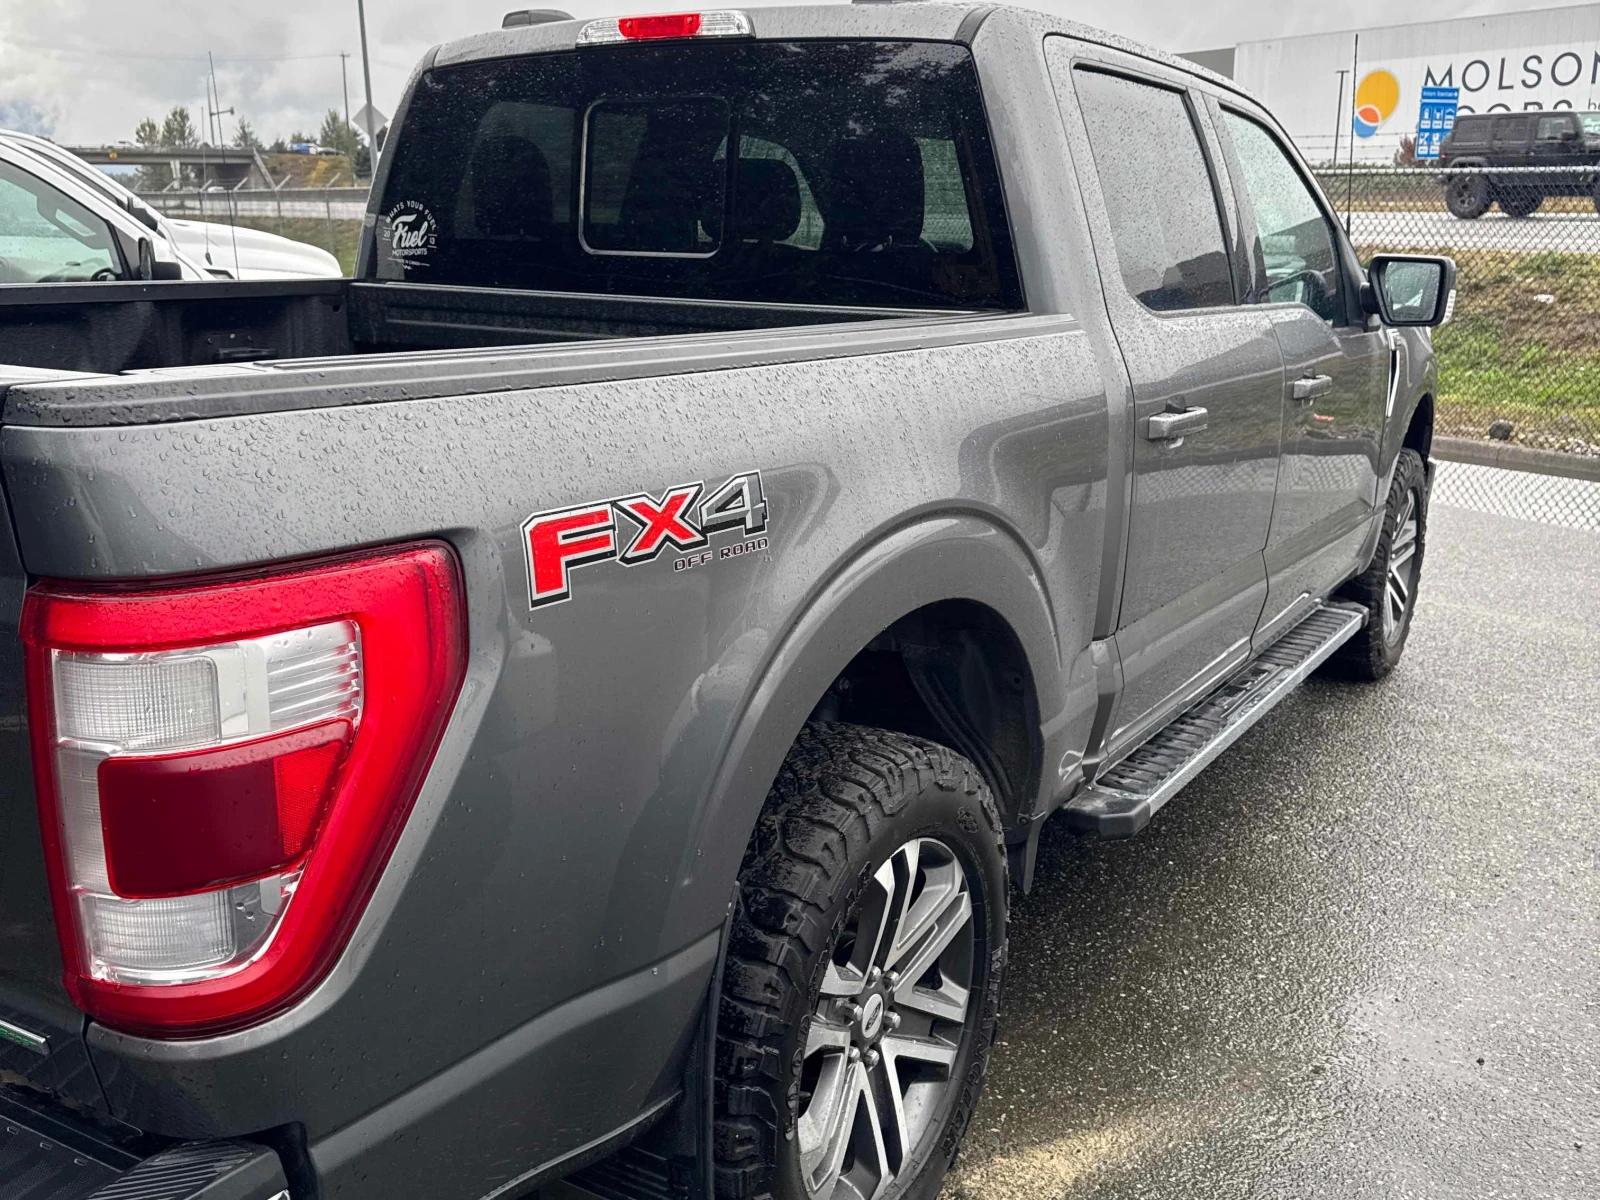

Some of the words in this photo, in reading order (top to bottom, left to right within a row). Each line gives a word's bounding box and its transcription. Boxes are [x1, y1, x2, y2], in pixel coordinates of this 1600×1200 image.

[385, 202, 405, 223] WHATS
[407, 200, 424, 211] YOUR
[424, 209, 437, 230] FUEL
[392, 213, 429, 249] Fuel
[392, 248, 427, 256] MOTORSPORTS
[520, 469, 769, 611] FX4
[674, 553, 713, 572] OFF
[720, 538, 769, 560] ROAD
